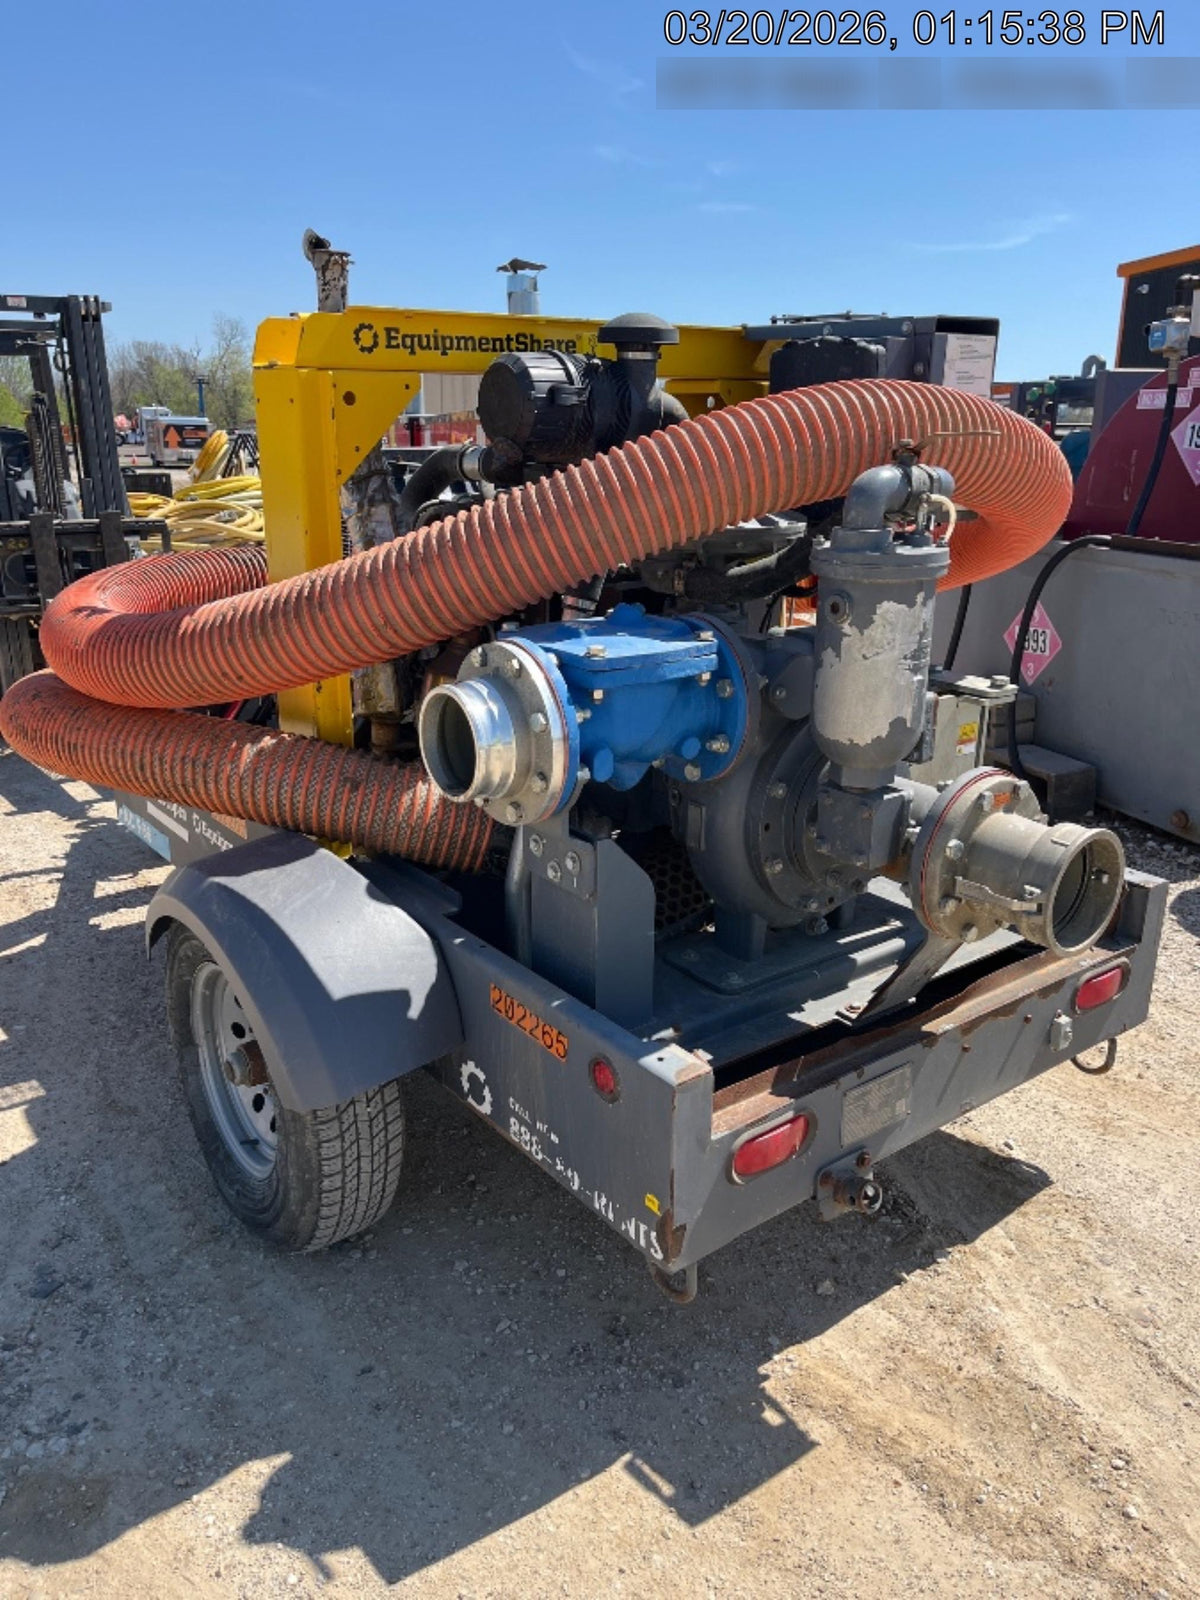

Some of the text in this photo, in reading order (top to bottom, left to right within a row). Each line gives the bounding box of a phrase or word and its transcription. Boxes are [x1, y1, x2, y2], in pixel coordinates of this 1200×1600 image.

[383, 326, 577, 356] EquipmentShare
[1026, 661, 1035, 677] 3
[491, 984, 568, 1059] 202265
